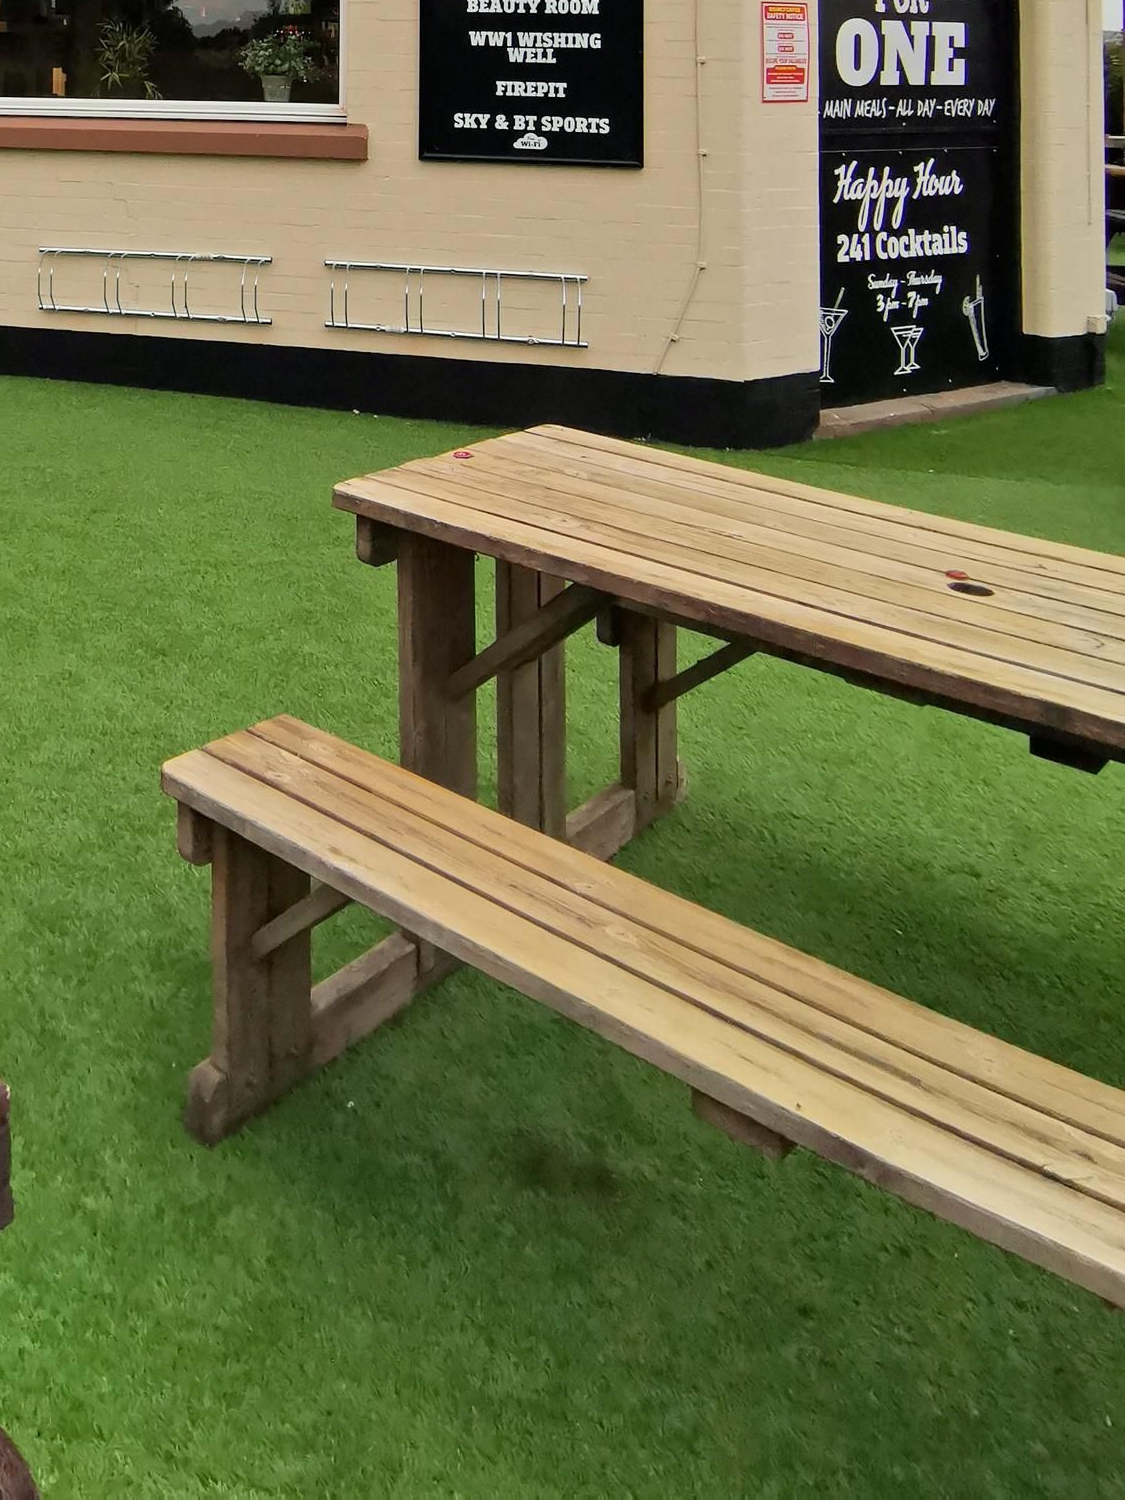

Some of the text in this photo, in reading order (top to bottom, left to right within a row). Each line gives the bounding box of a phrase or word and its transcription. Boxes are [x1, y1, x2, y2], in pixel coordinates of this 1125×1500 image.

[544, 0, 600, 14] ROOM
[468, 31, 602, 49] WW1 WISHING
[507, 48, 557, 64] WELL
[835, 17, 967, 87] ONE
[495, 81, 567, 98] FIREPIT
[823, 98, 852, 120] MAIN
[854, 97, 888, 119] MEALS
[895, 98, 914, 118] ALL
[917, 98, 936, 118] DAY
[944, 97, 975, 118] EVERY
[977, 98, 996, 117] DAY
[453, 113, 610, 134] SKY & BT SPORTS
[833, 157, 963, 232] Happy Hour
[837, 225, 968, 263] 241 Cocktails
[867, 272, 899, 299] Sunday
